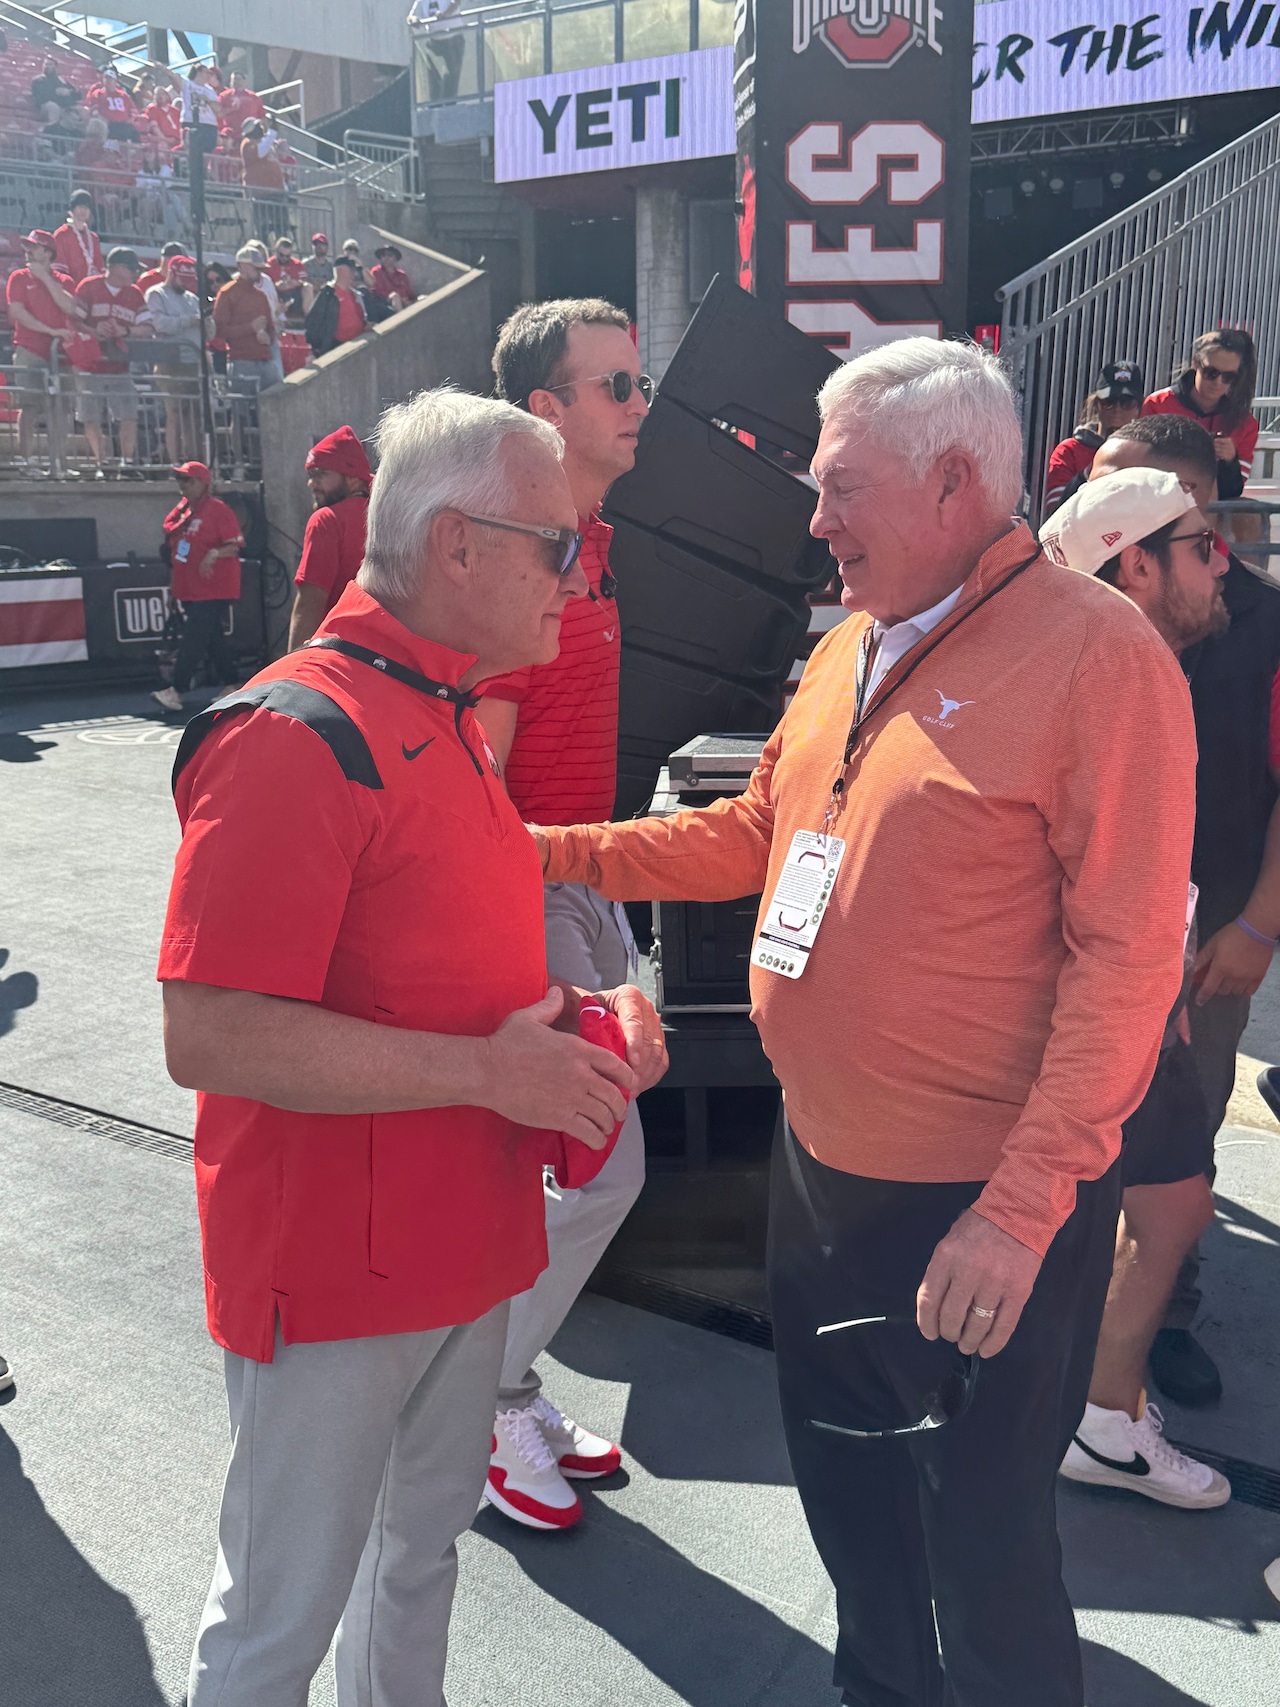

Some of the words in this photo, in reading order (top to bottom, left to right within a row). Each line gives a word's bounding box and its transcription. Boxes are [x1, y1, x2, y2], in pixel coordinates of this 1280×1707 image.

[1047, 14, 1165, 76] THE
[527, 77, 680, 154] YETI
[922, 715, 939, 725] GOLF
